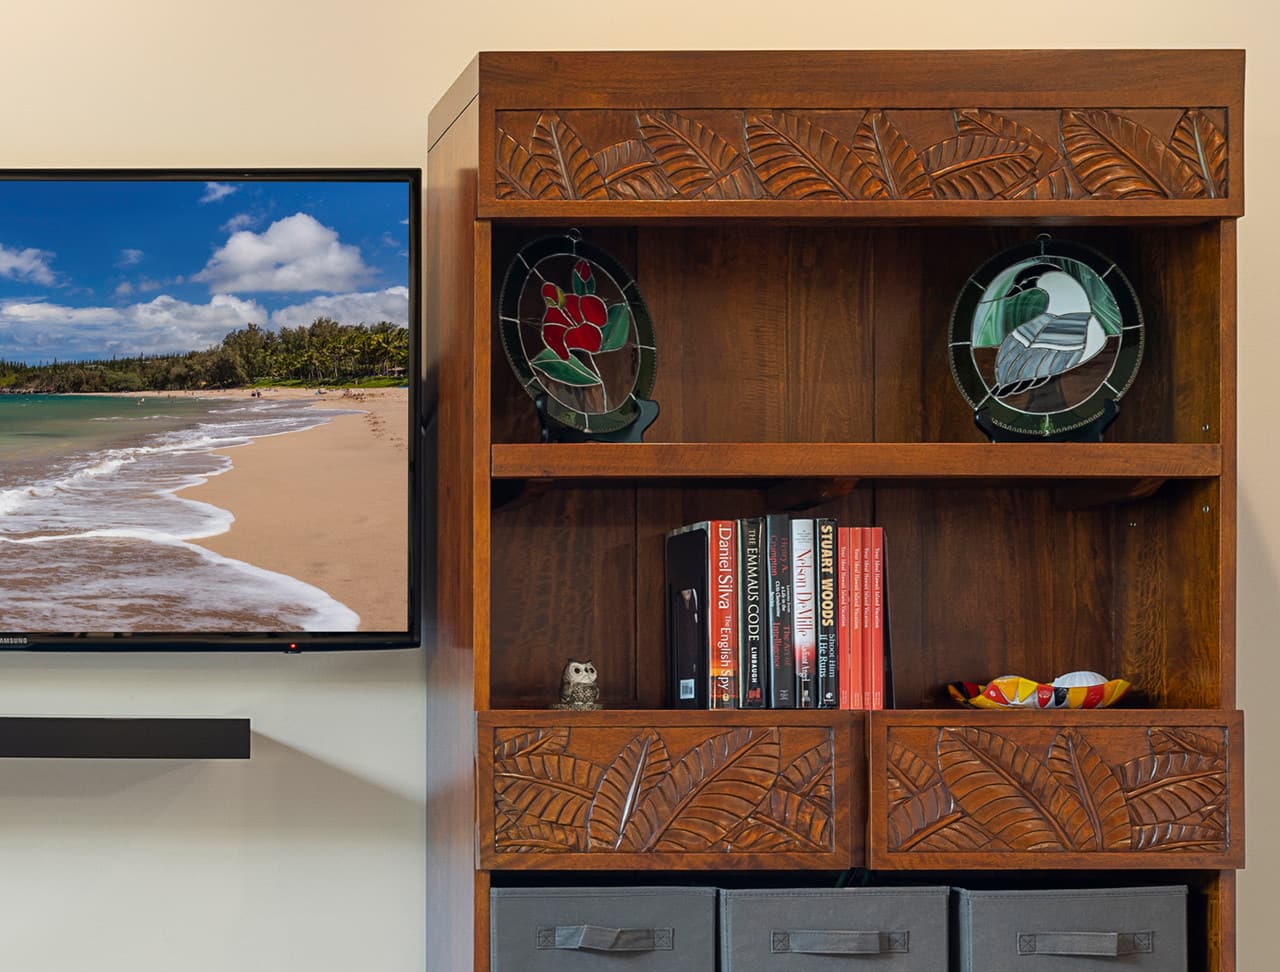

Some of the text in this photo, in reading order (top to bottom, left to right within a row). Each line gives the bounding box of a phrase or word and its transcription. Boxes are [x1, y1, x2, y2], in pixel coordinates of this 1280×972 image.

[780, 537, 789, 563] Henry
[795, 548, 812, 589] Nelson
[718, 574, 733, 609] Silva
[747, 529, 760, 641] THE EMMAUS CODE
[821, 524, 834, 627] STUART WOODS
[795, 592, 813, 637] DeMille
[717, 615, 732, 690] The English Spy
[819, 642, 828, 654] He
[819, 656, 828, 678] Runs
[828, 633, 836, 678] Shoot Him
